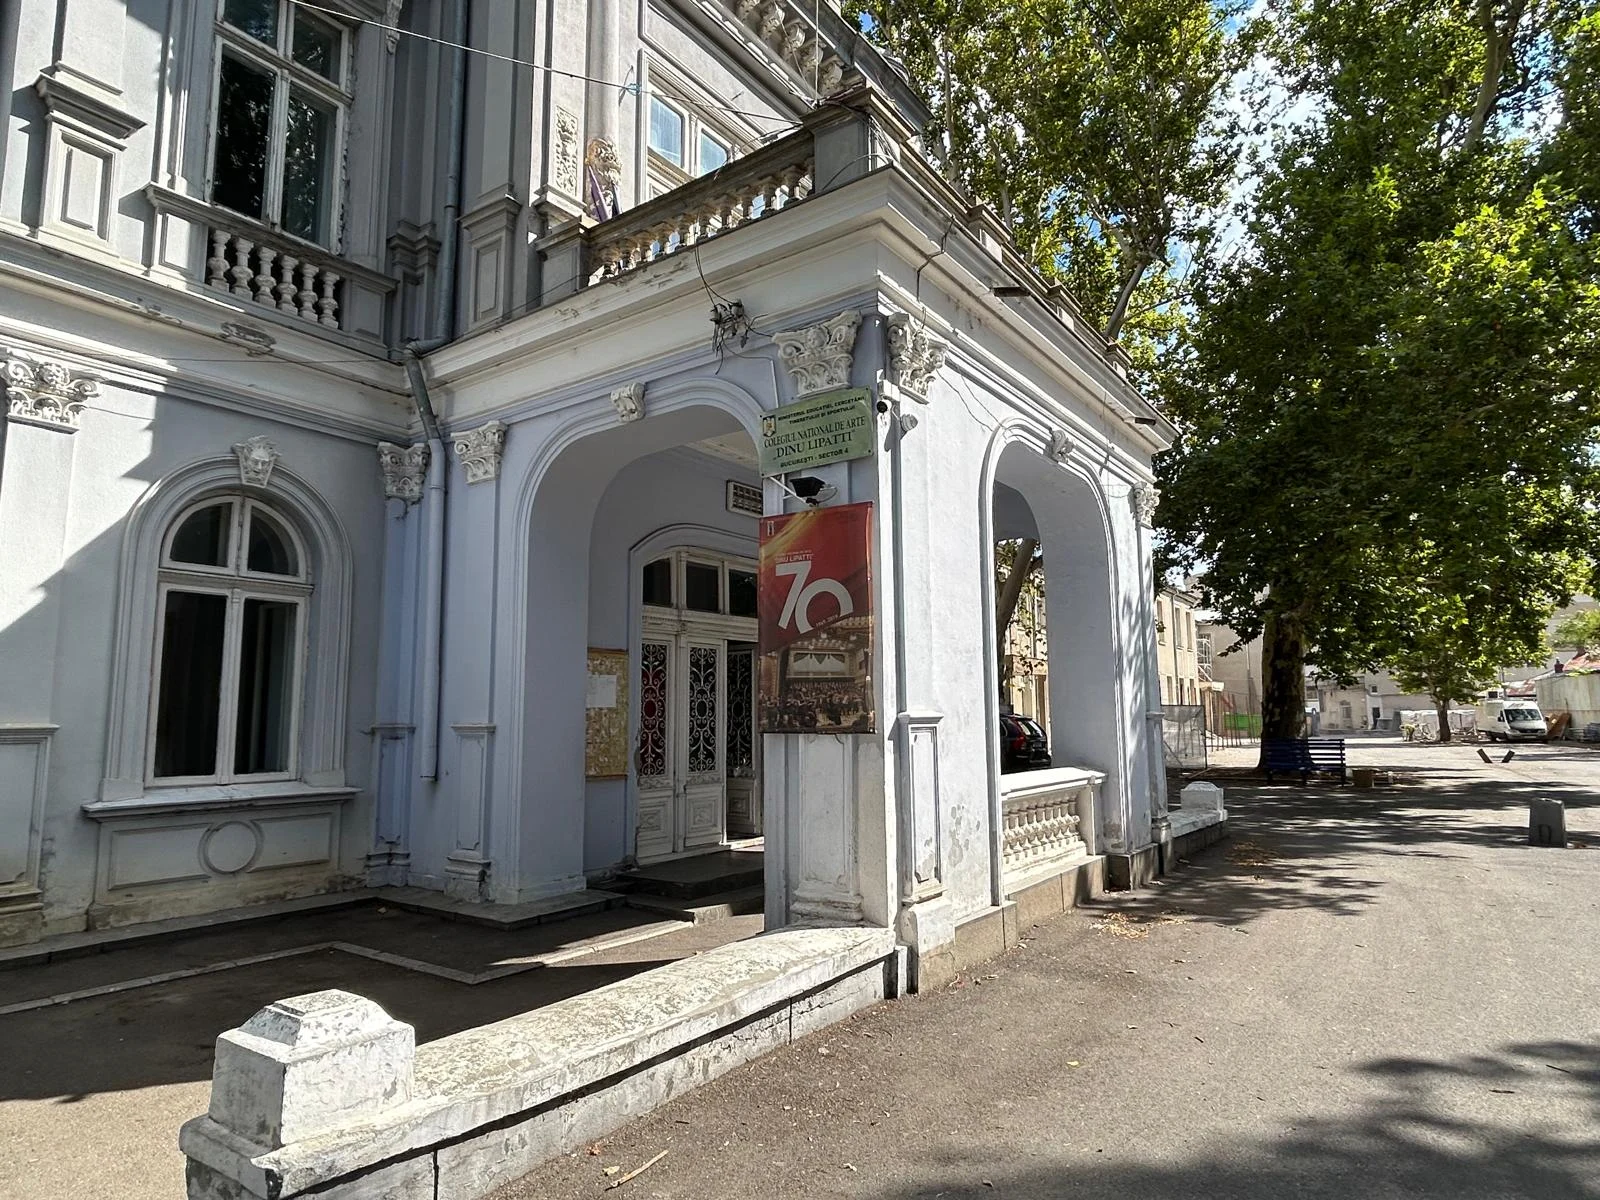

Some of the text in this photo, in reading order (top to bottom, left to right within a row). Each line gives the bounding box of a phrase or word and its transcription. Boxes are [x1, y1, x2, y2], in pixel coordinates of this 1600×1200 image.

[764, 432, 796, 448] COLEGIUL
[834, 420, 845, 432] DE
[846, 415, 865, 430] ARTE
[818, 448, 843, 459] SECTOR
[775, 560, 854, 635] 70
